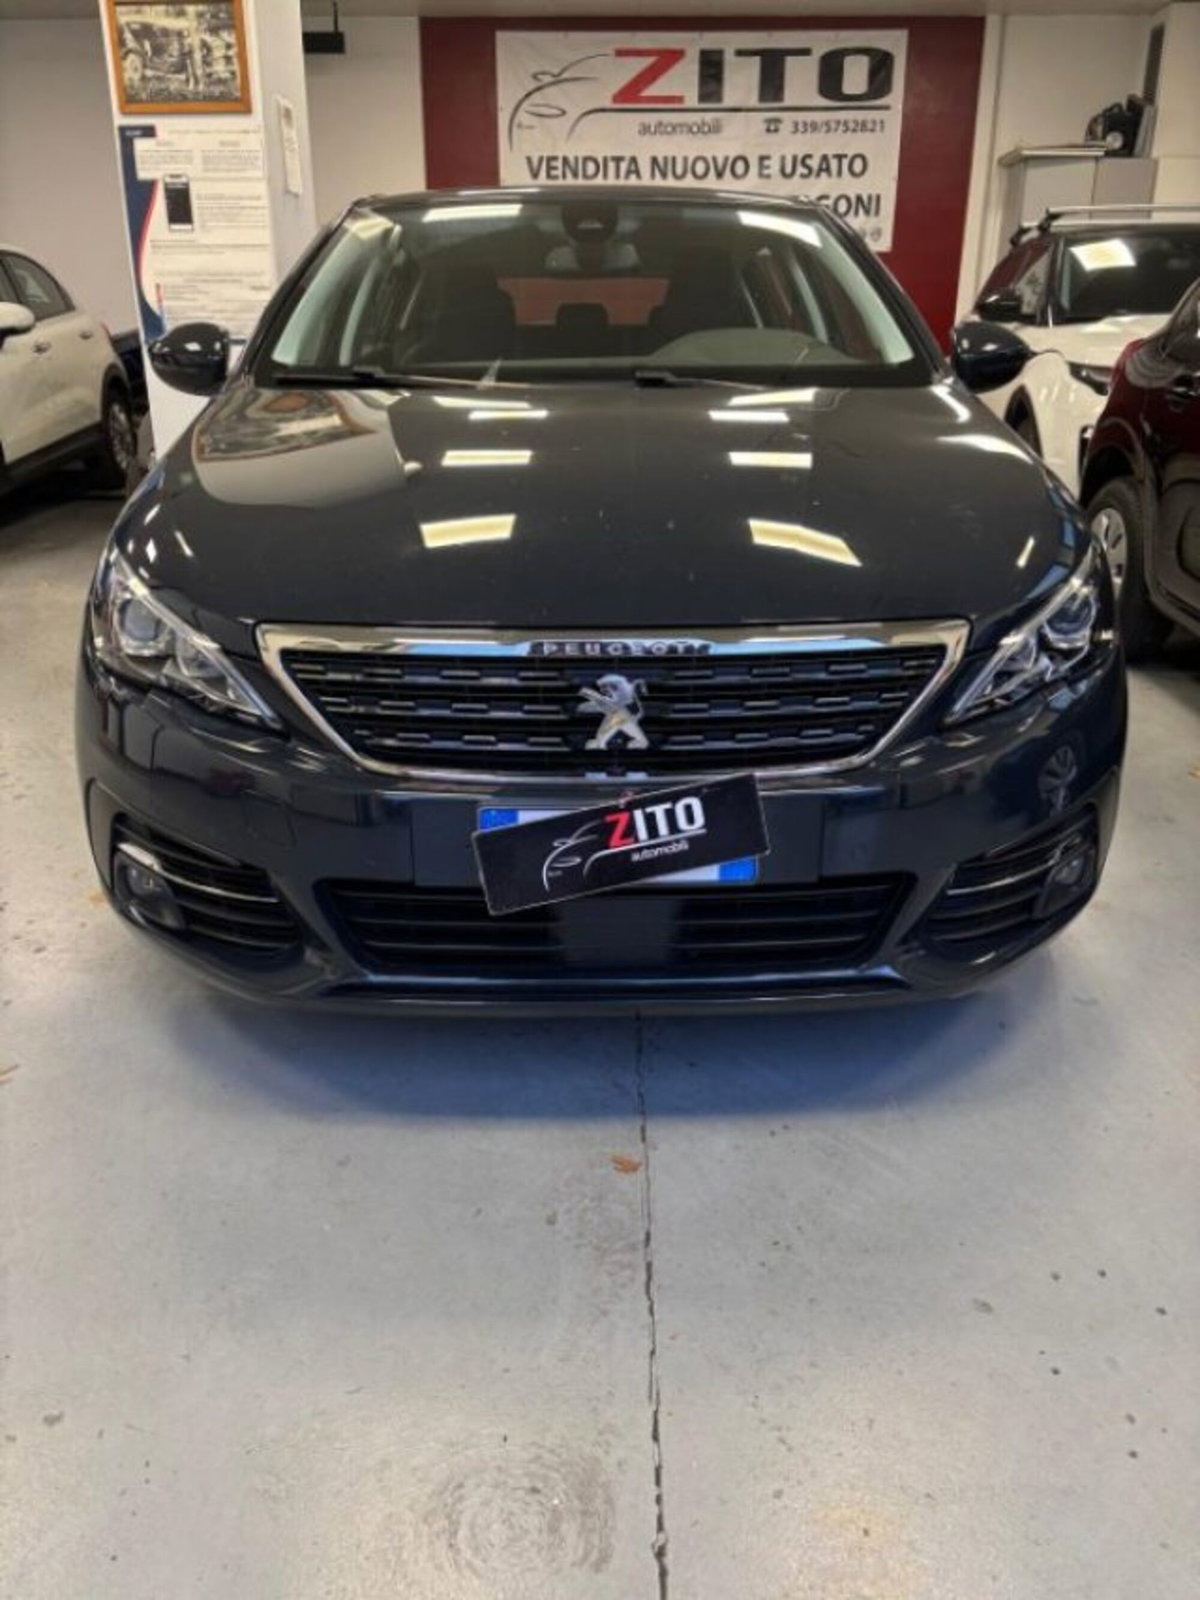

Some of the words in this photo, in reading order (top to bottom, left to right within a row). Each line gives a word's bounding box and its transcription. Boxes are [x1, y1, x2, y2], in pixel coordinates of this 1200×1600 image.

[611, 46, 895, 104] ZITO
[637, 118, 724, 136] automobili
[526, 154, 642, 181] VENDITA
[650, 154, 750, 181] NUOVO
[757, 154, 772, 180] E
[779, 153, 868, 180] USATO
[543, 640, 691, 656] PEUGEOT
[604, 796, 706, 850] ZITO
[631, 840, 689, 862] automobili
